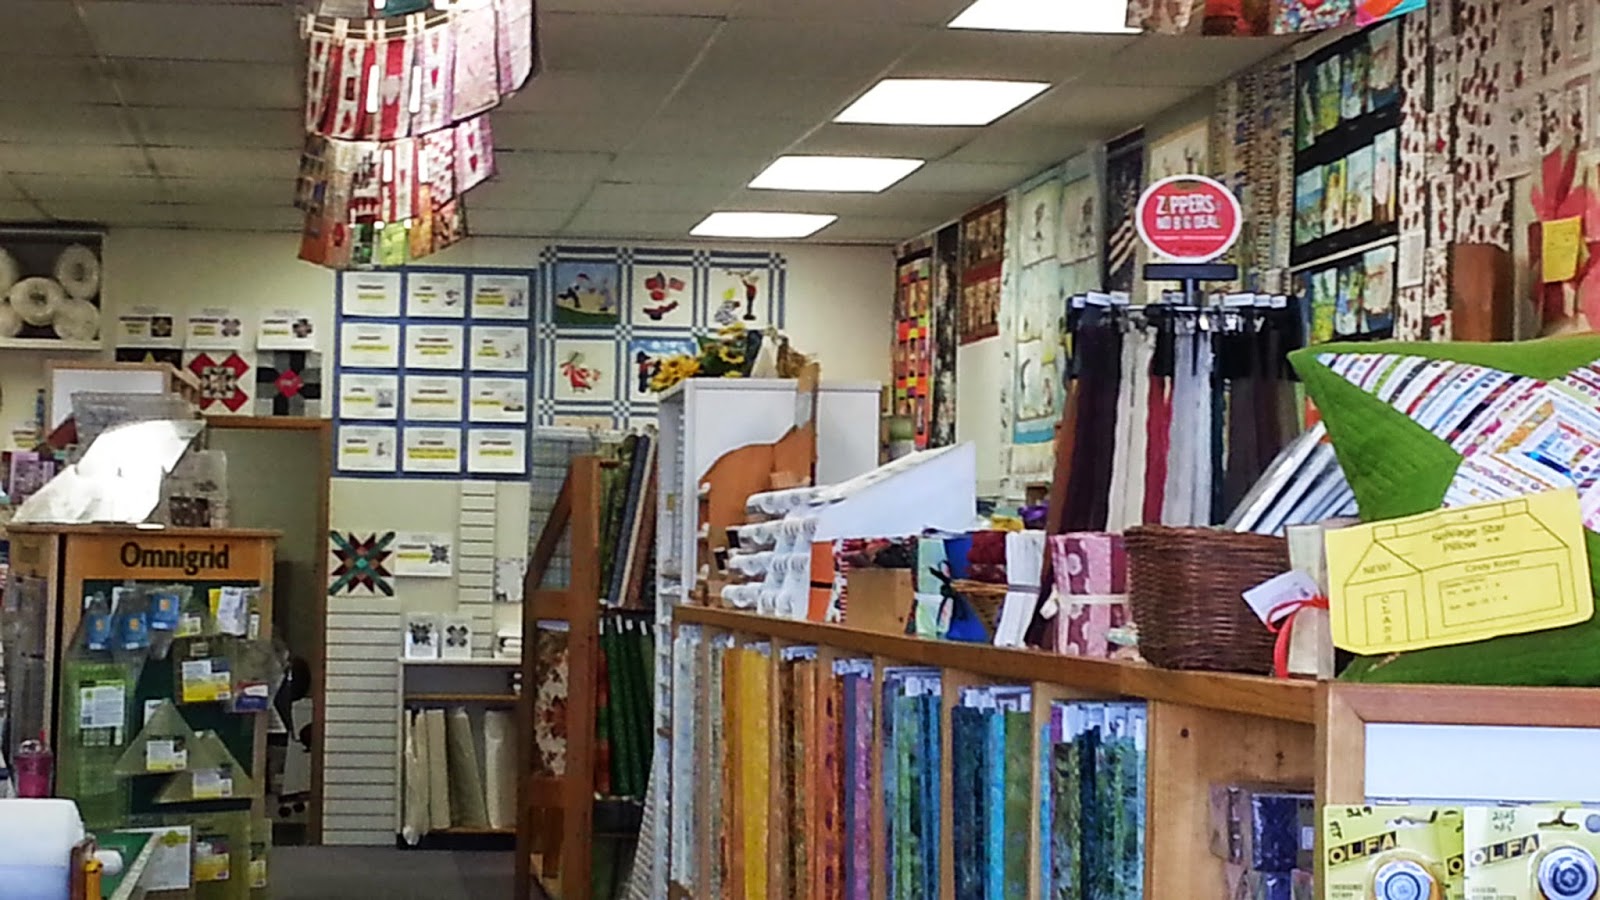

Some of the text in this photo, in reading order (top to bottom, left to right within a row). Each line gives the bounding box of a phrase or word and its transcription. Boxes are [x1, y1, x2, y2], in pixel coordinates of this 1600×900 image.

[1156, 194, 1216, 214] ZPPERS
[120, 541, 229, 575] Omnigrid
[1329, 832, 1396, 865] OLFA
[1471, 835, 1538, 865] OLFA
